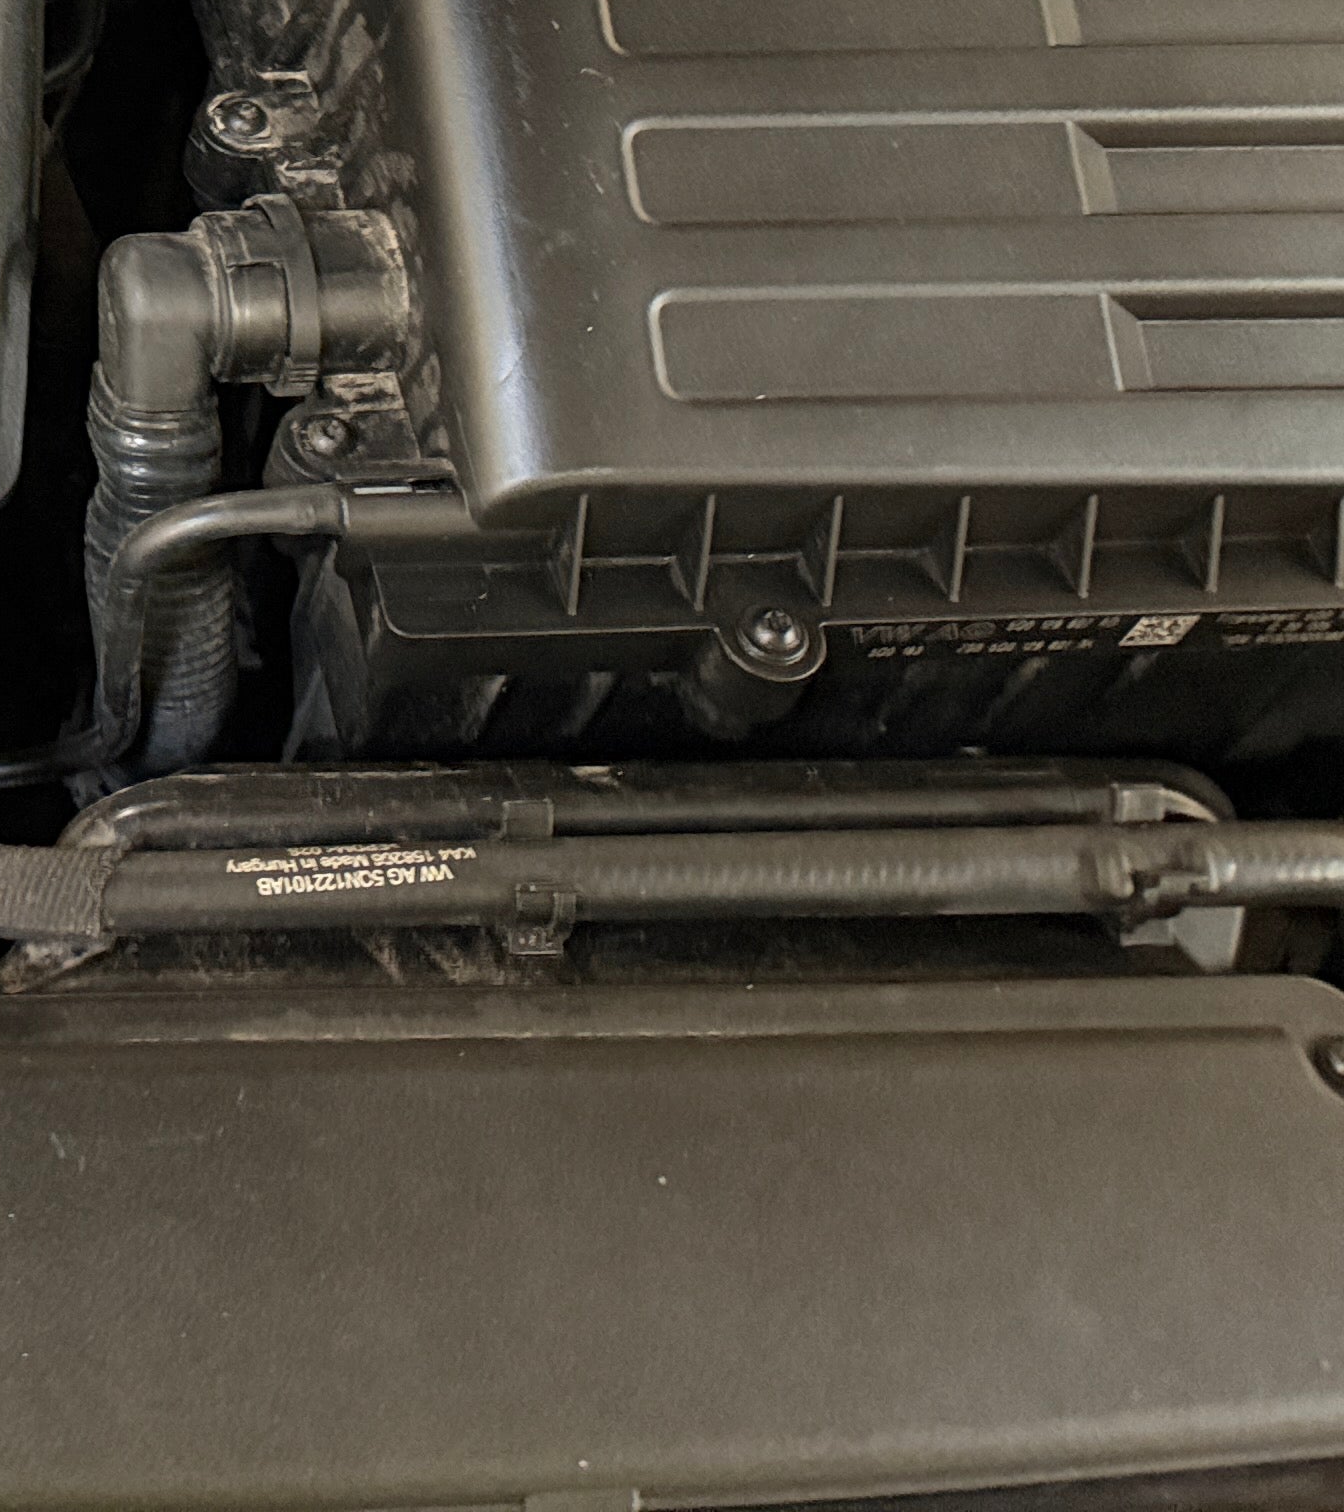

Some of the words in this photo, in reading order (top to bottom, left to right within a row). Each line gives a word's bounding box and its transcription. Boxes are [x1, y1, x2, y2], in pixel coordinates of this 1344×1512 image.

[225, 857, 300, 873] Hungary
[301, 857, 319, 871] in
[319, 854, 370, 869] Made
[386, 866, 416, 885] AG
[420, 864, 455, 882] VW
